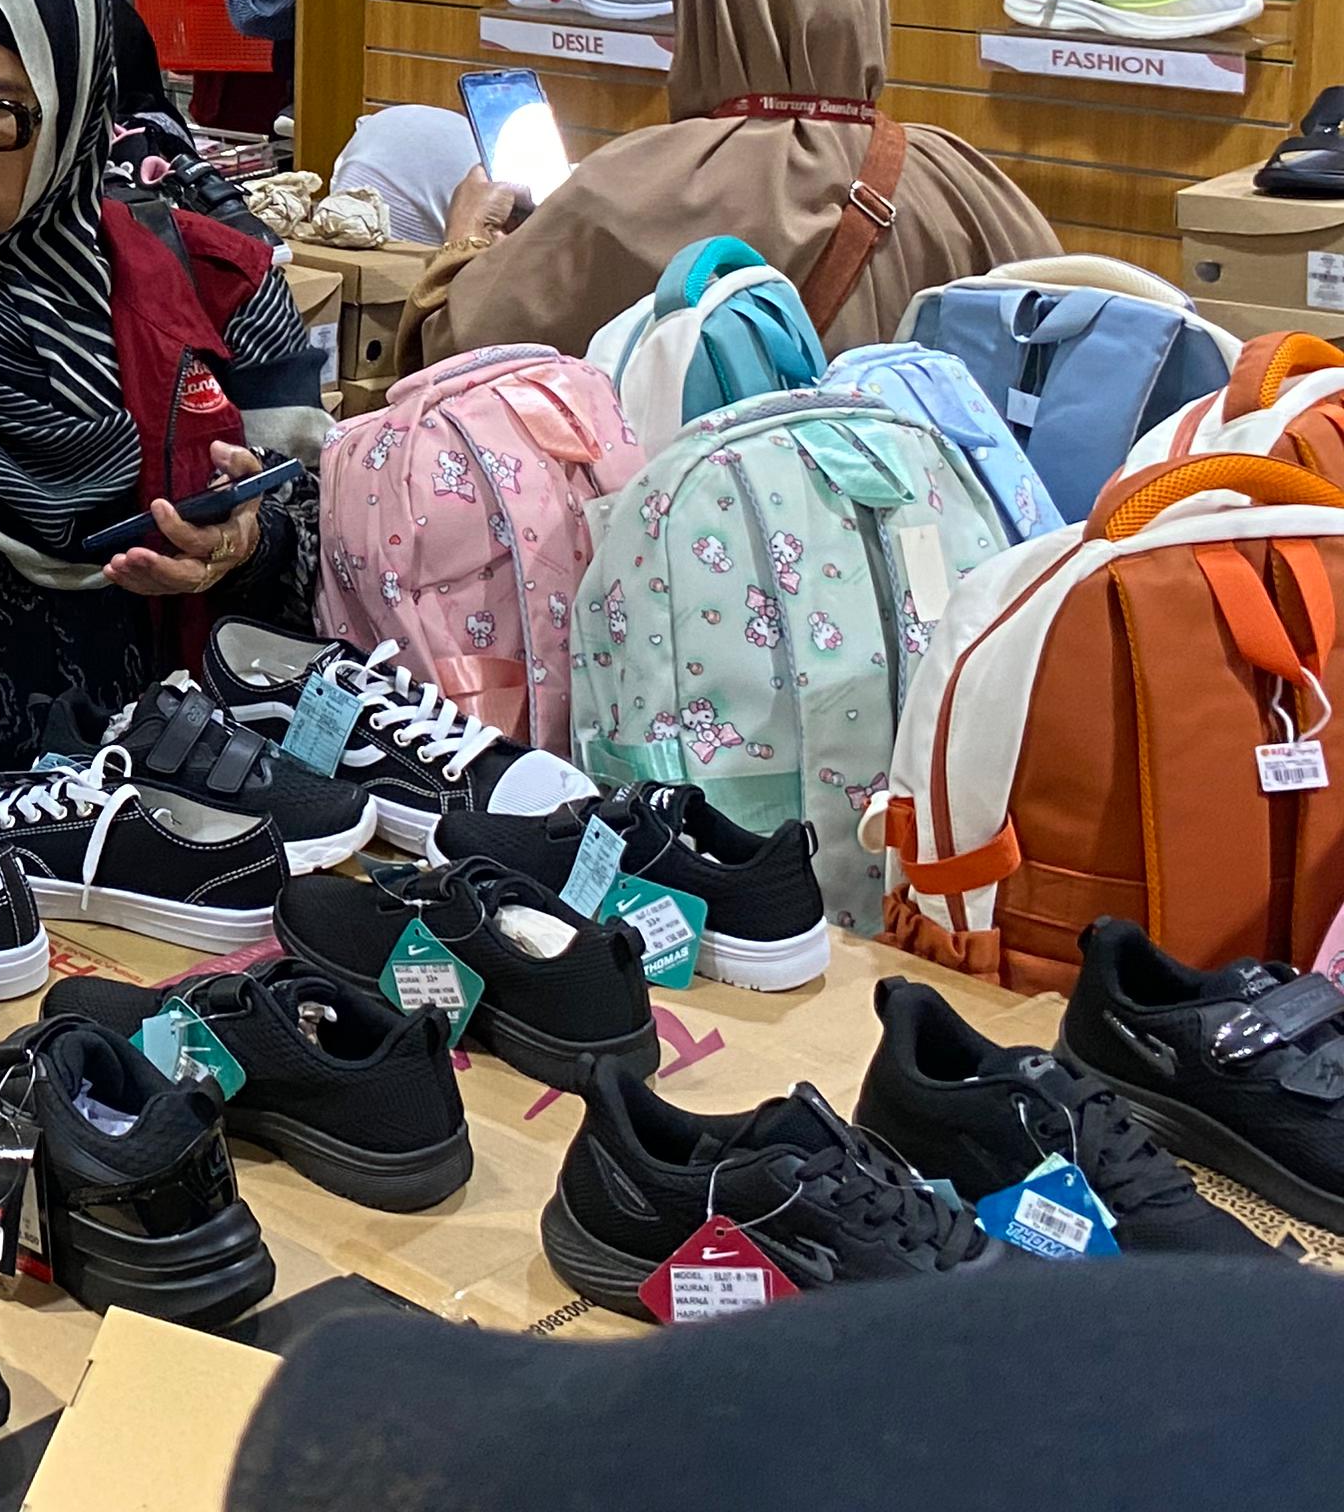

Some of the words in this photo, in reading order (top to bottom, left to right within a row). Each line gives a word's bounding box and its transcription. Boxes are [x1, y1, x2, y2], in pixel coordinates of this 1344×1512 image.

[552, 31, 604, 55] DESLE
[1050, 45, 1166, 78] FASHION
[643, 946, 689, 976] THOMAS
